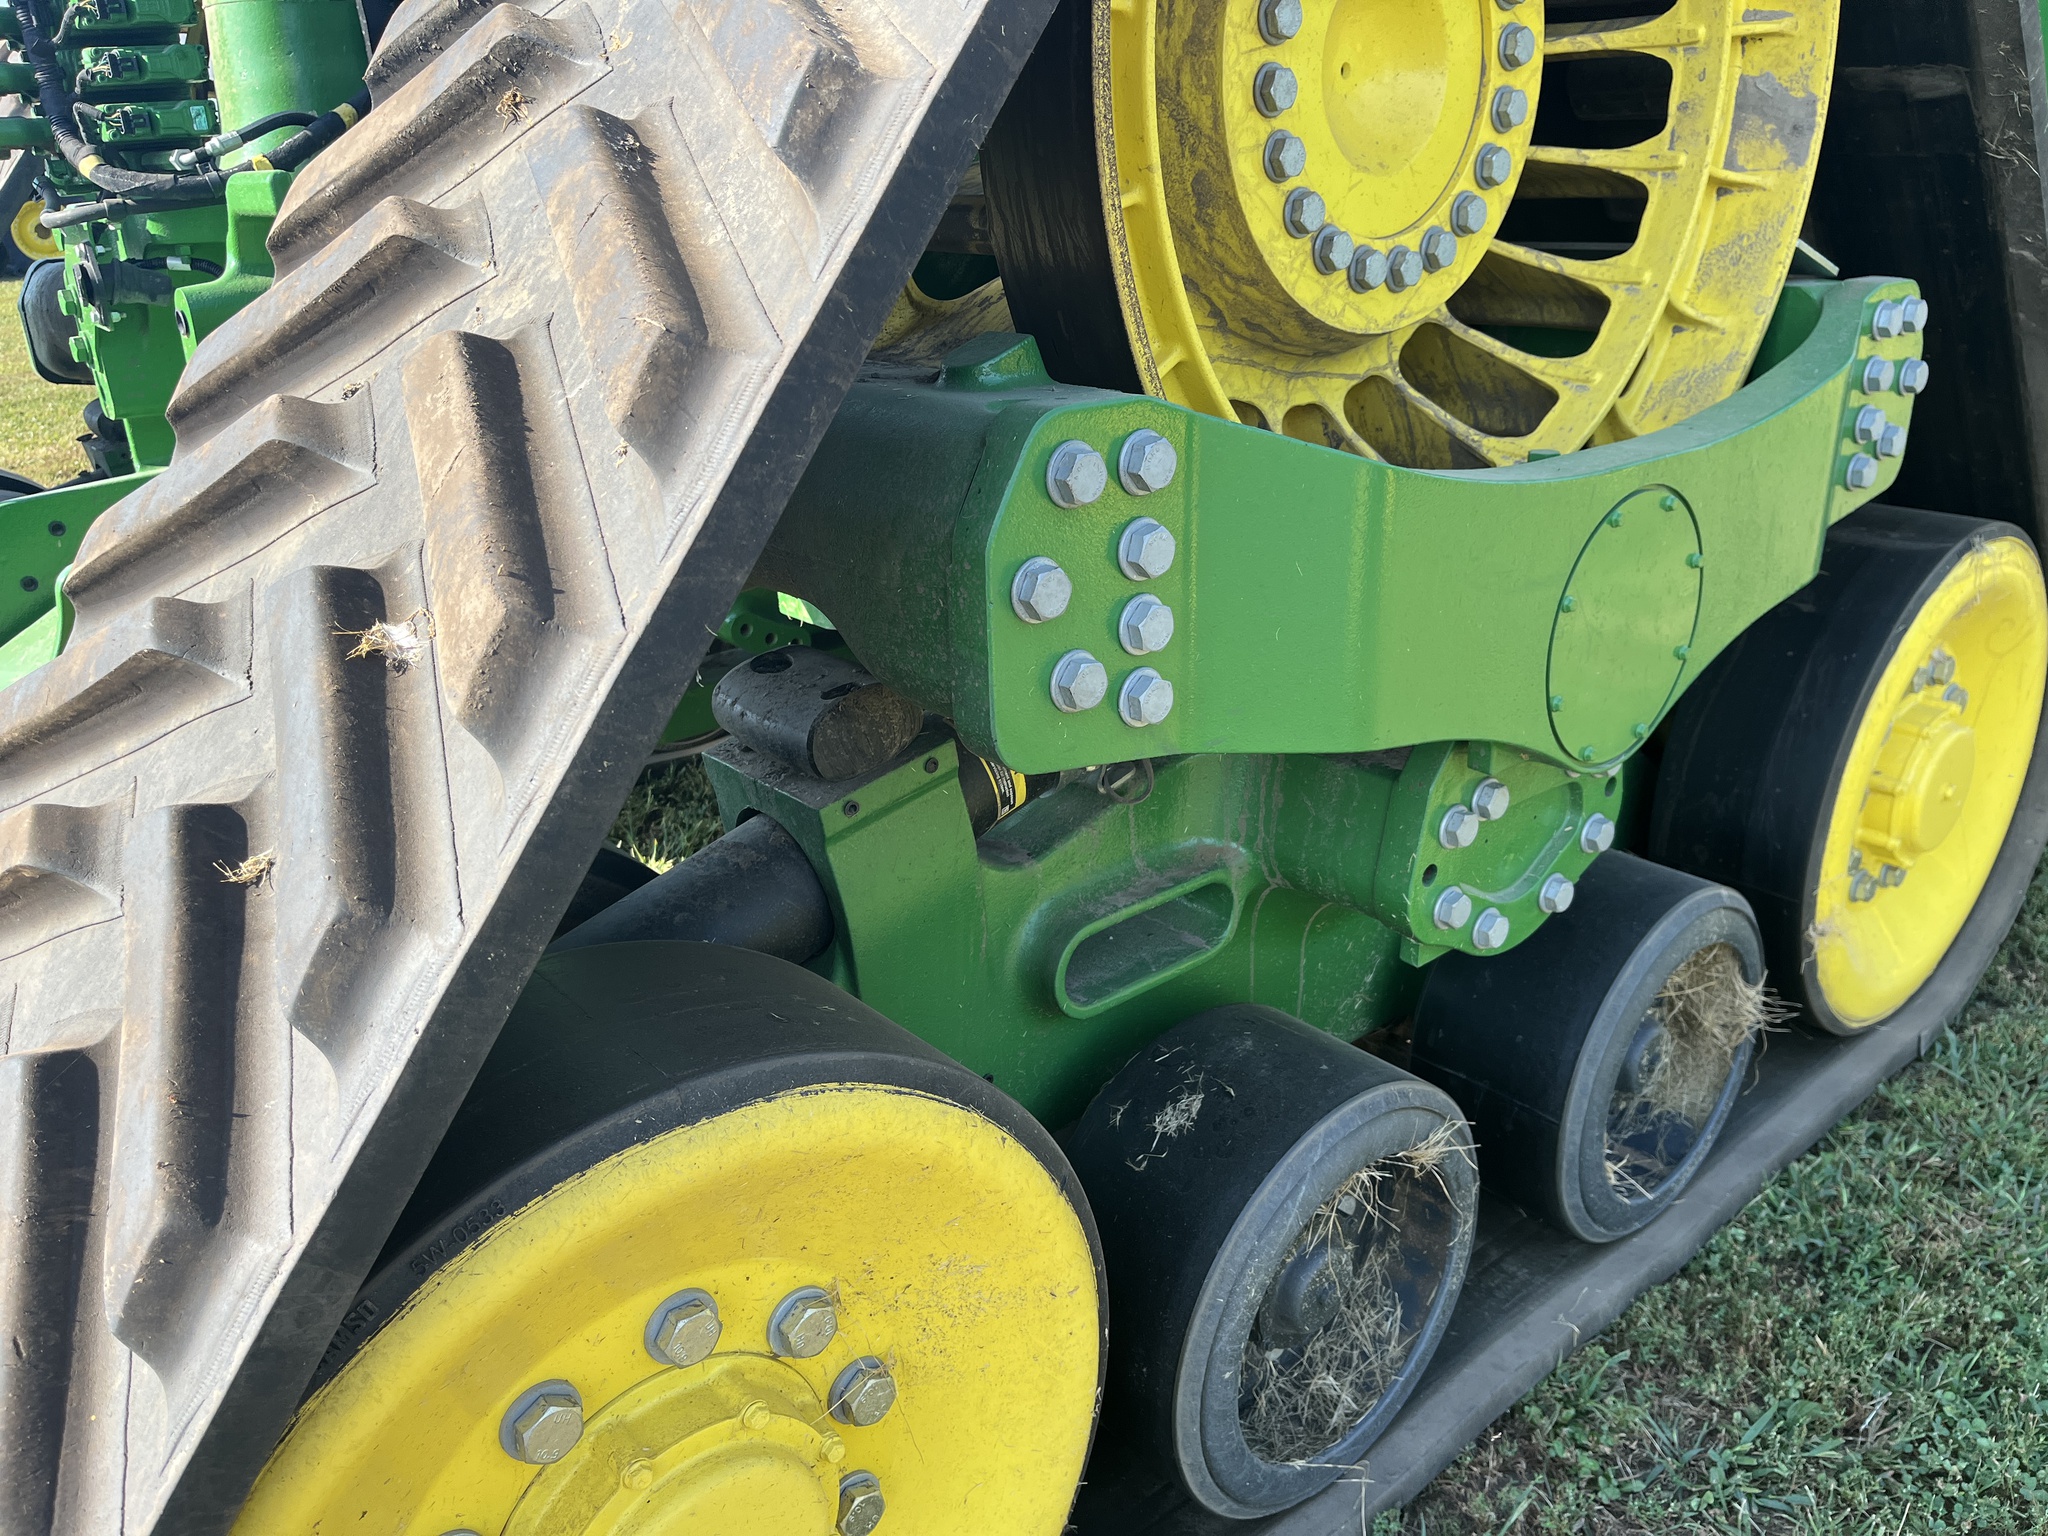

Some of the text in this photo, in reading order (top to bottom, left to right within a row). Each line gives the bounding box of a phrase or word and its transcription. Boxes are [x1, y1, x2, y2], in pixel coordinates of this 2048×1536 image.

[411, 1199, 506, 1276] 5W-0533
[673, 1341, 689, 1362] 10.9
[553, 1412, 572, 1425] UH
[535, 1448, 560, 1461] 10.9
